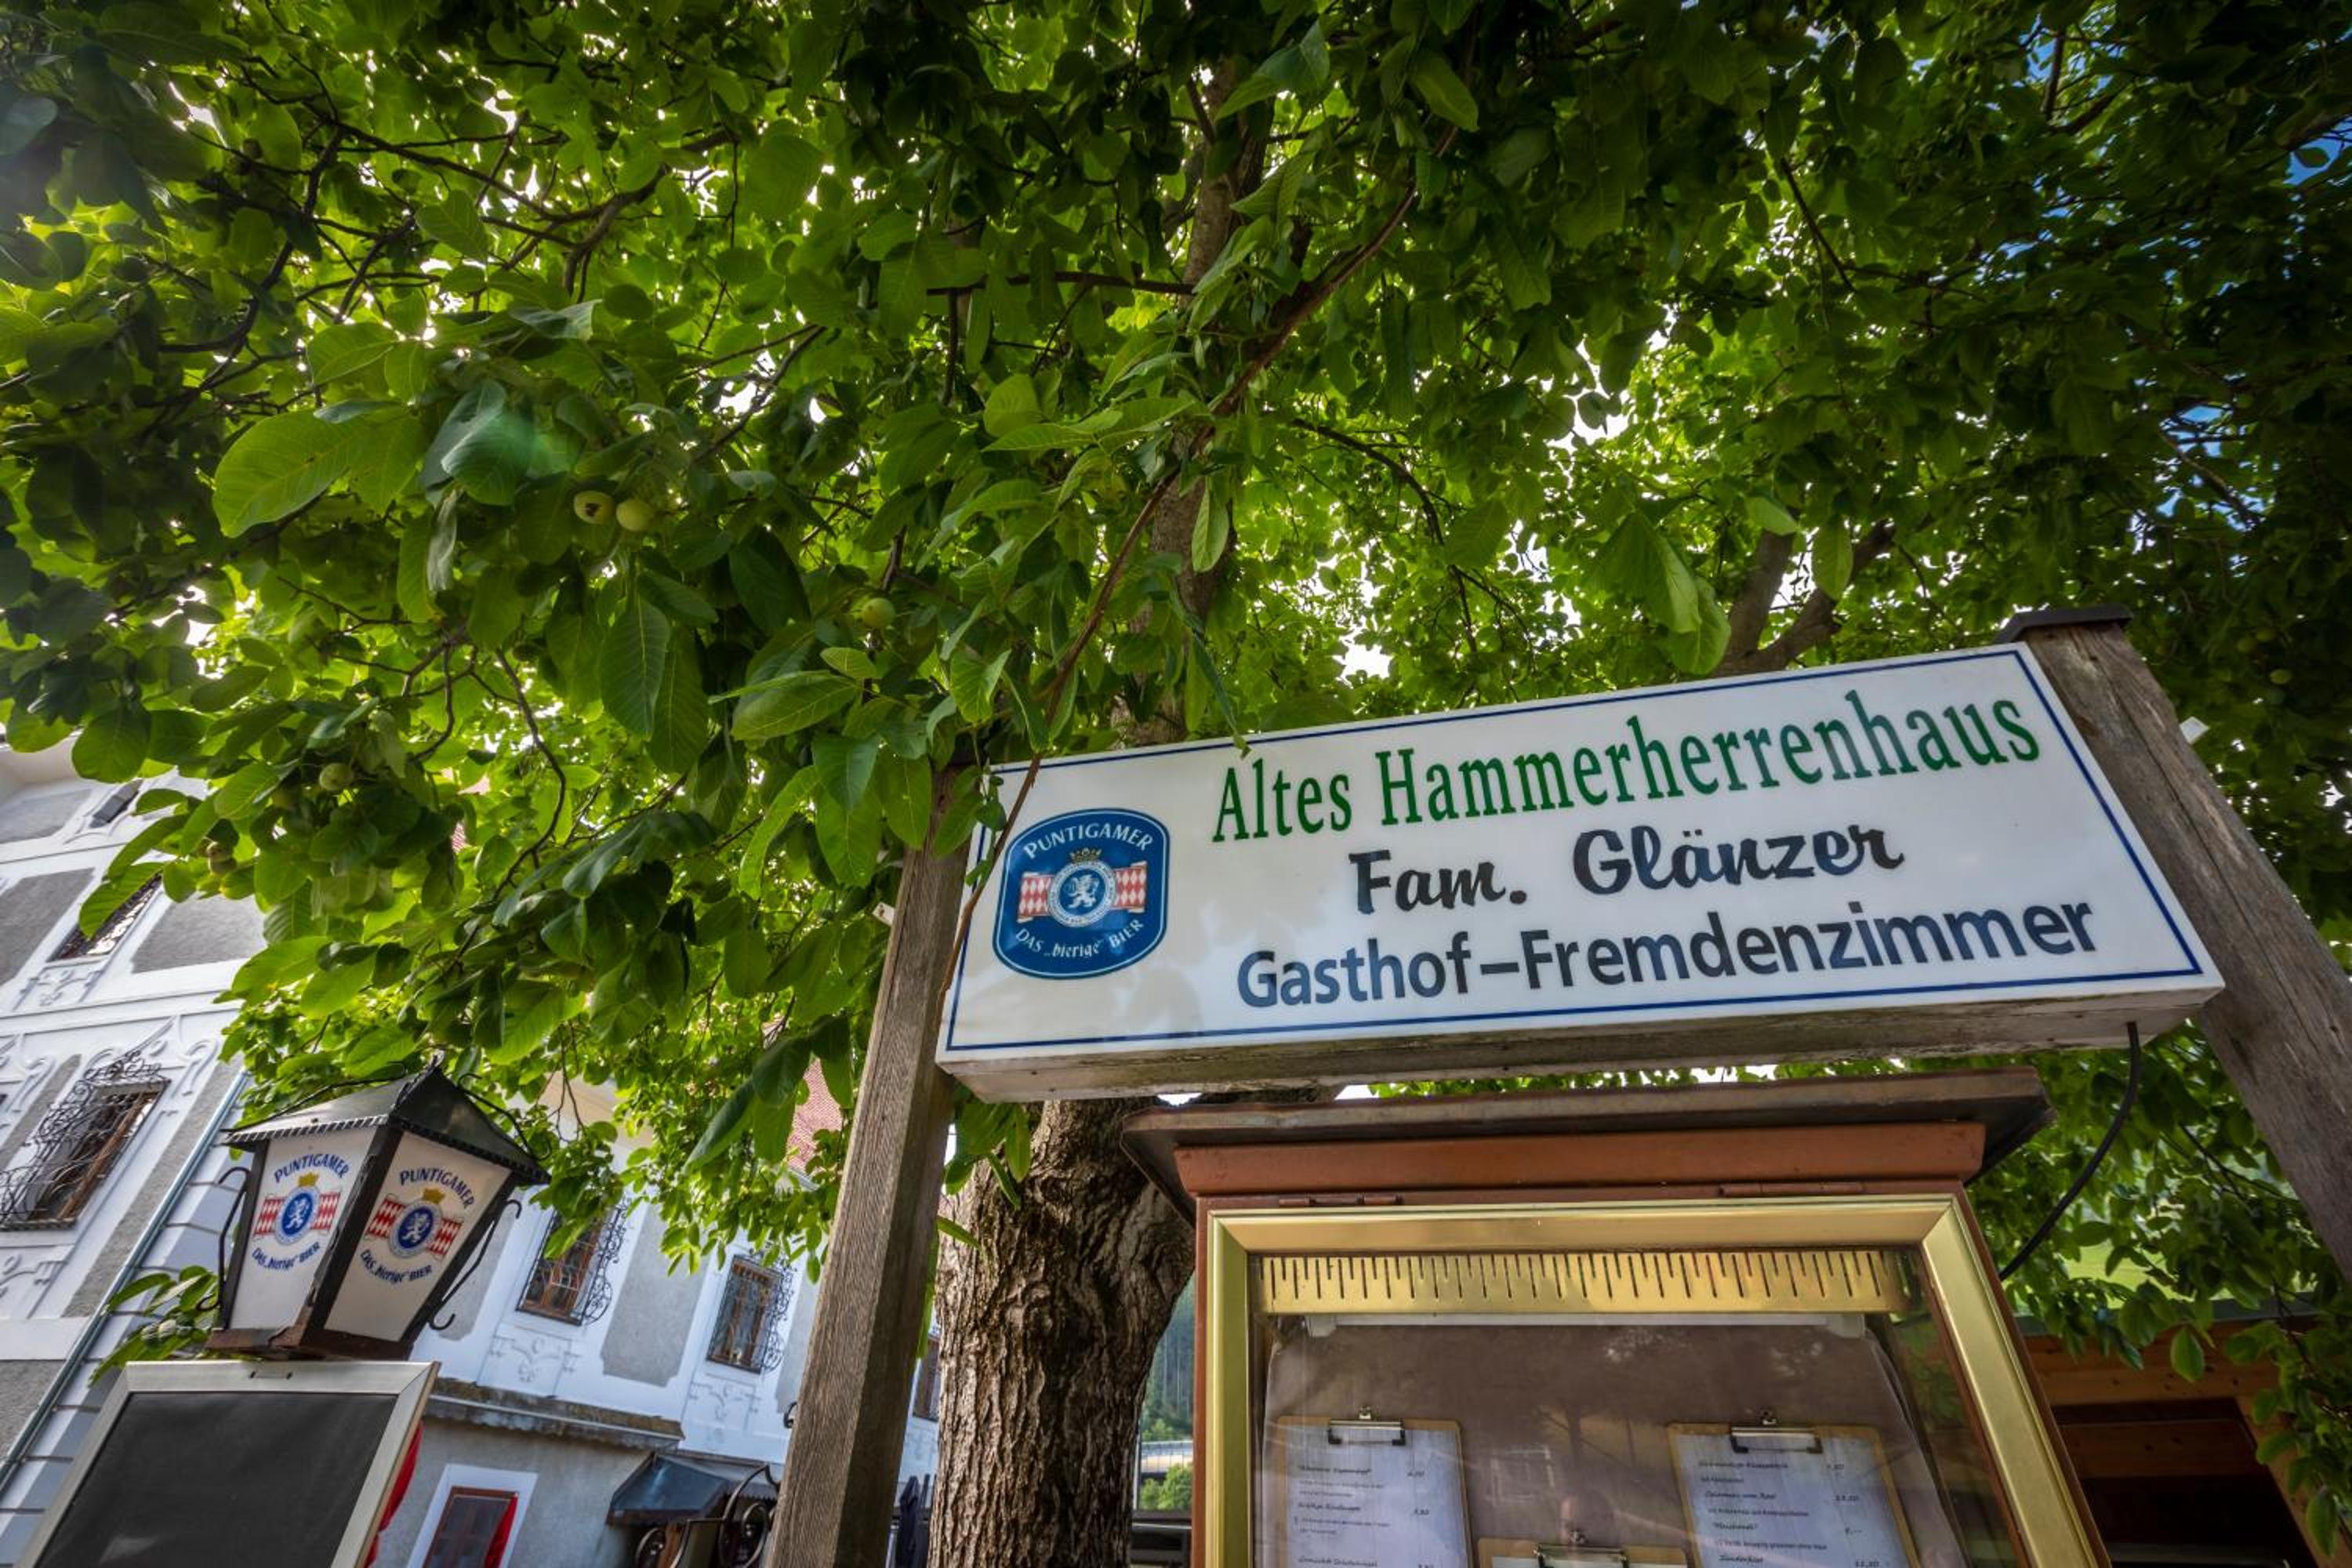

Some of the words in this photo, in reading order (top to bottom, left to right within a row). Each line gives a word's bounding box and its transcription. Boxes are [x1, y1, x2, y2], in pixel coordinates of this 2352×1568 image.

[1212, 757, 1352, 843] Altes
[1375, 688, 2040, 826] Hammerherrenhaus
[1023, 822, 1153, 860] PUNTIGAMER
[1348, 849, 1528, 915] Fam.
[1573, 824, 1905, 896] Glänzer
[1015, 927, 1044, 953] DAS
[1108, 918, 1145, 949] BIER
[274, 1153, 350, 1185] PUNTIGAMER
[399, 1166, 475, 1210] PUNTIGAMER
[408, 1264, 433, 1282] BIER
